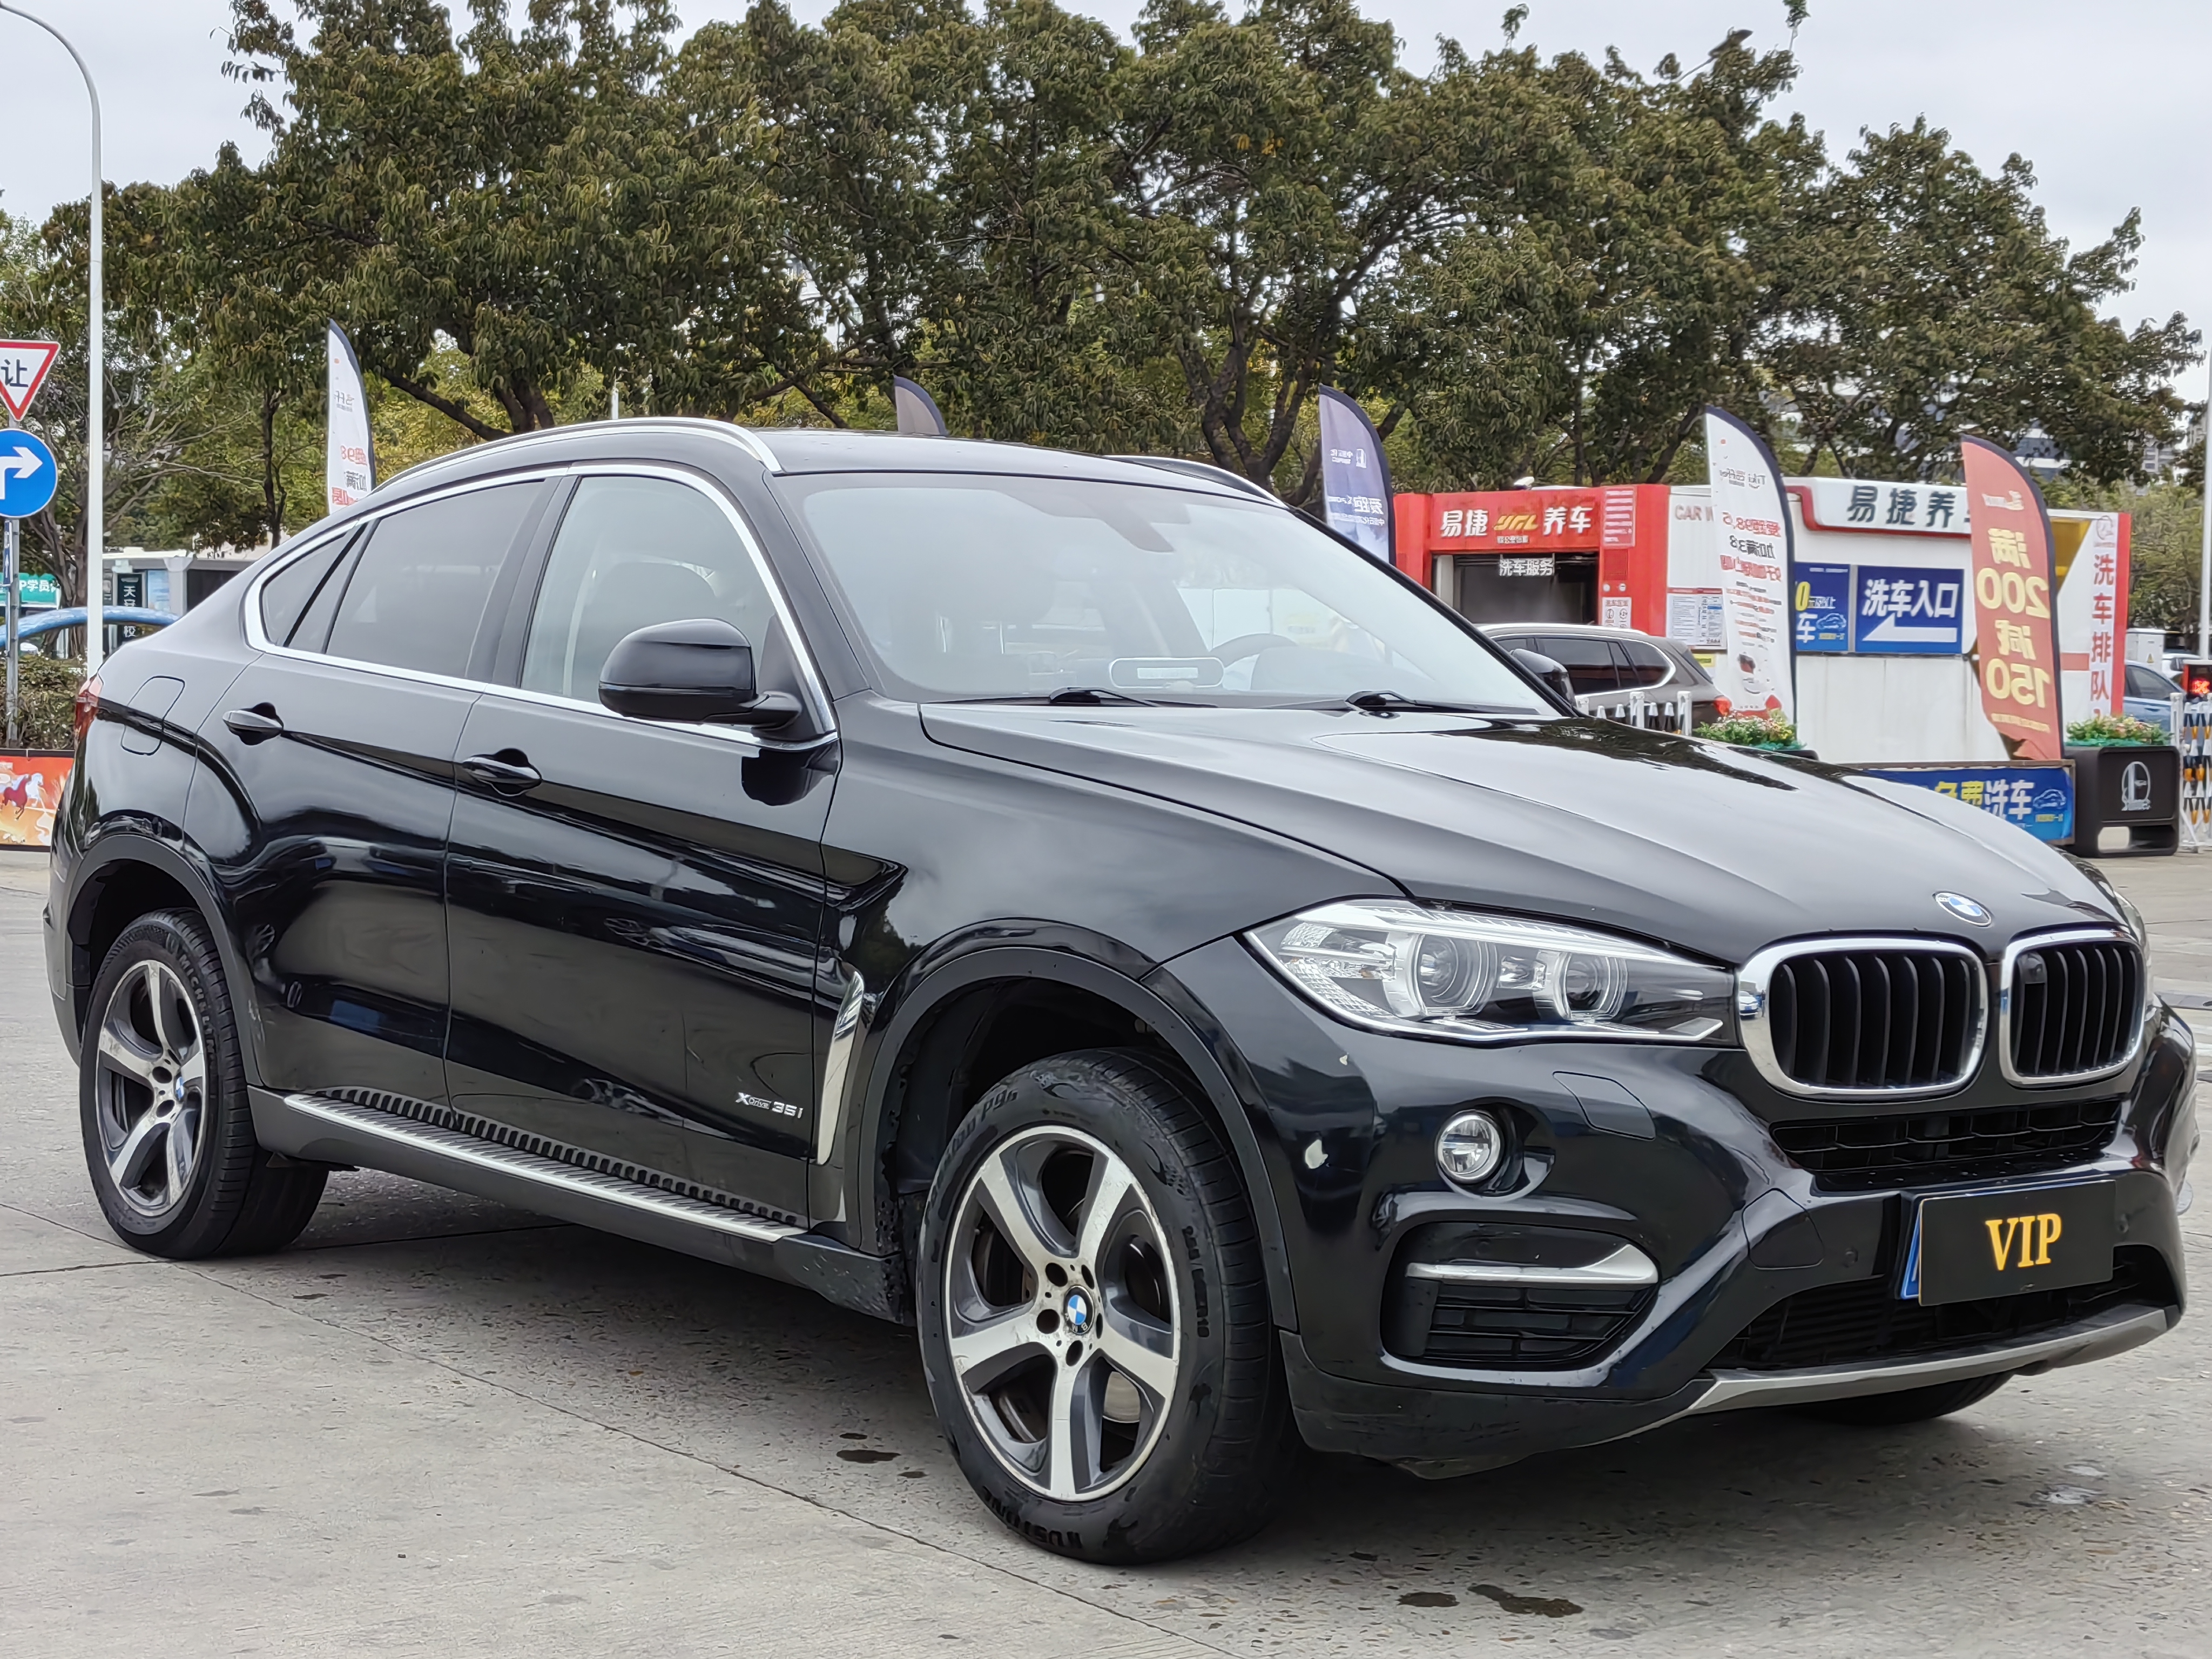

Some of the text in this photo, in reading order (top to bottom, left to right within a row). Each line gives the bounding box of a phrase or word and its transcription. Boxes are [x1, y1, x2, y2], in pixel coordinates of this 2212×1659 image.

[1, 360, 29, 388] 让
[1440, 509, 1488, 536] 易捷
[1543, 505, 1593, 536] 养车
[1675, 504, 1702, 521] CAR
[1847, 485, 1970, 528] 易捷养
[1499, 557, 1554, 577] 洗车服务
[1862, 578, 1959, 618] 洗车入口
[1985, 1213, 2062, 1271] VIP
